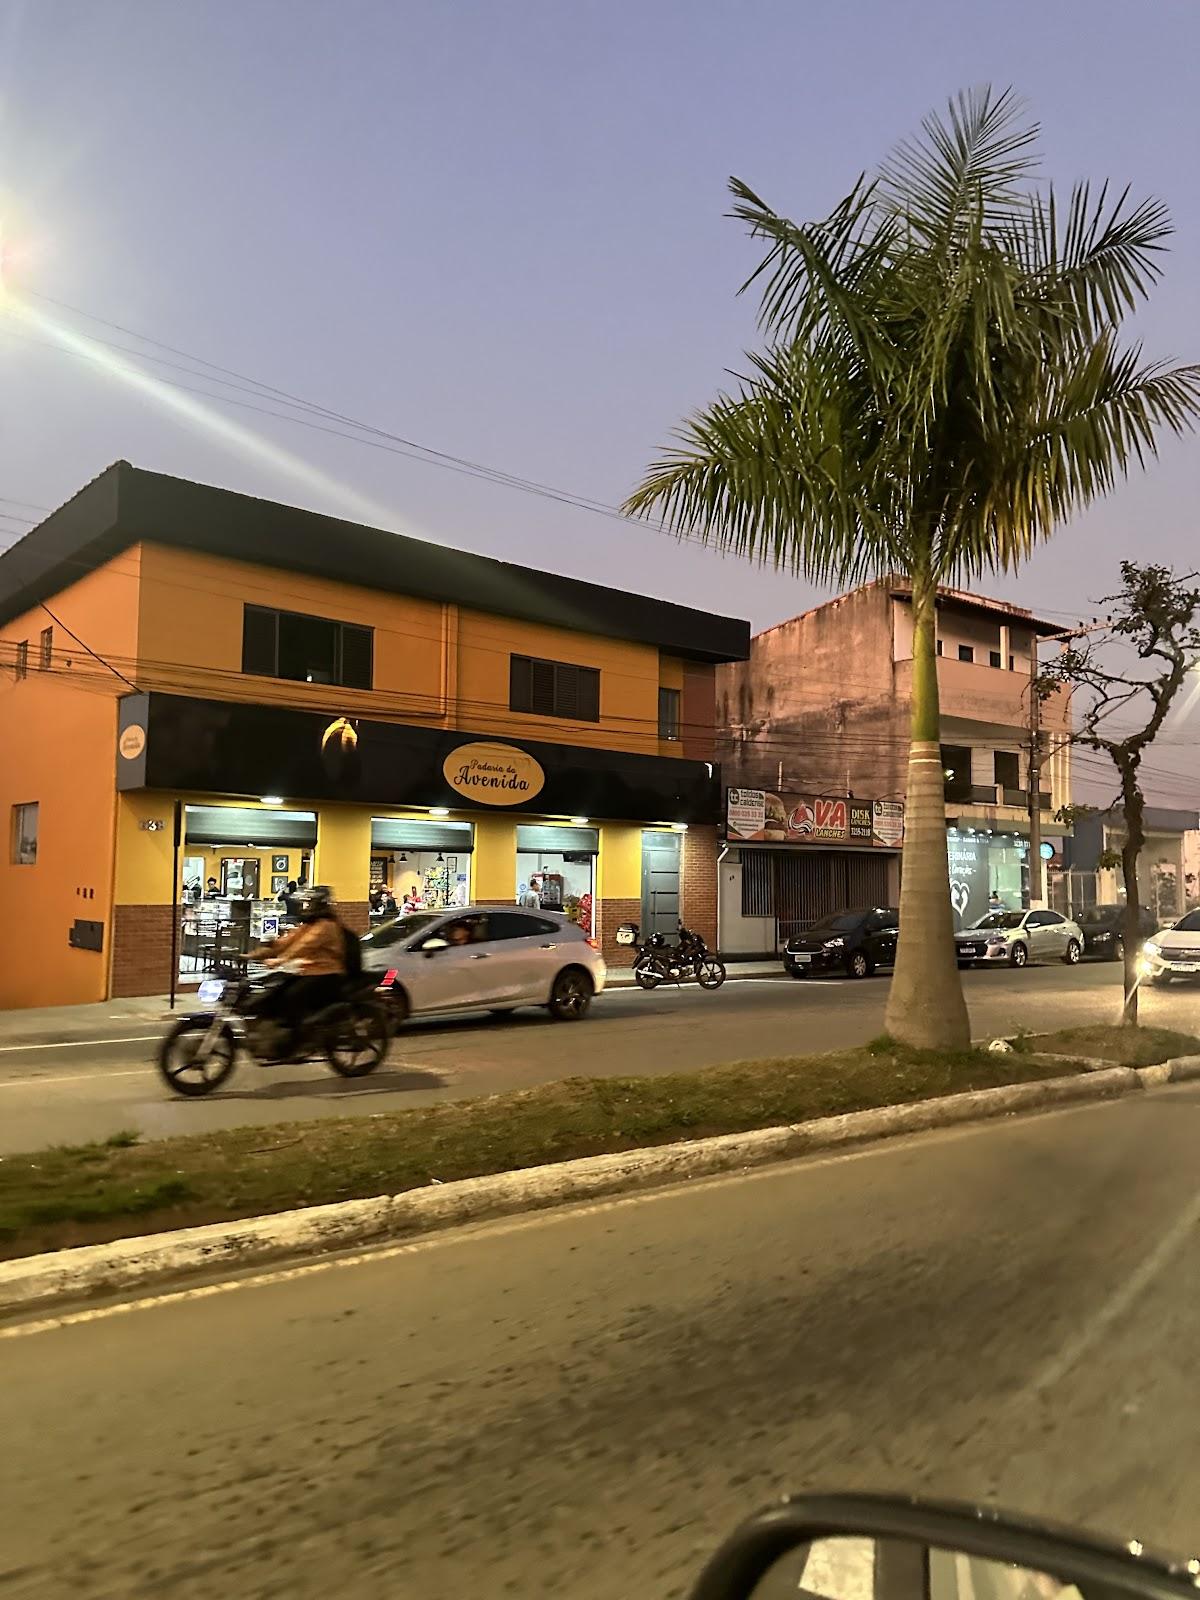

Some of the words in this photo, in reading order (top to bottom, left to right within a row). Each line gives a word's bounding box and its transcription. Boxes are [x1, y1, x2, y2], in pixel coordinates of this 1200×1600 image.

[470, 759, 503, 773] Padaria
[506, 765, 516, 774] da
[454, 766, 530, 790] Avenida
[851, 809, 871, 820] DISK
[815, 828, 846, 839] LANCHES
